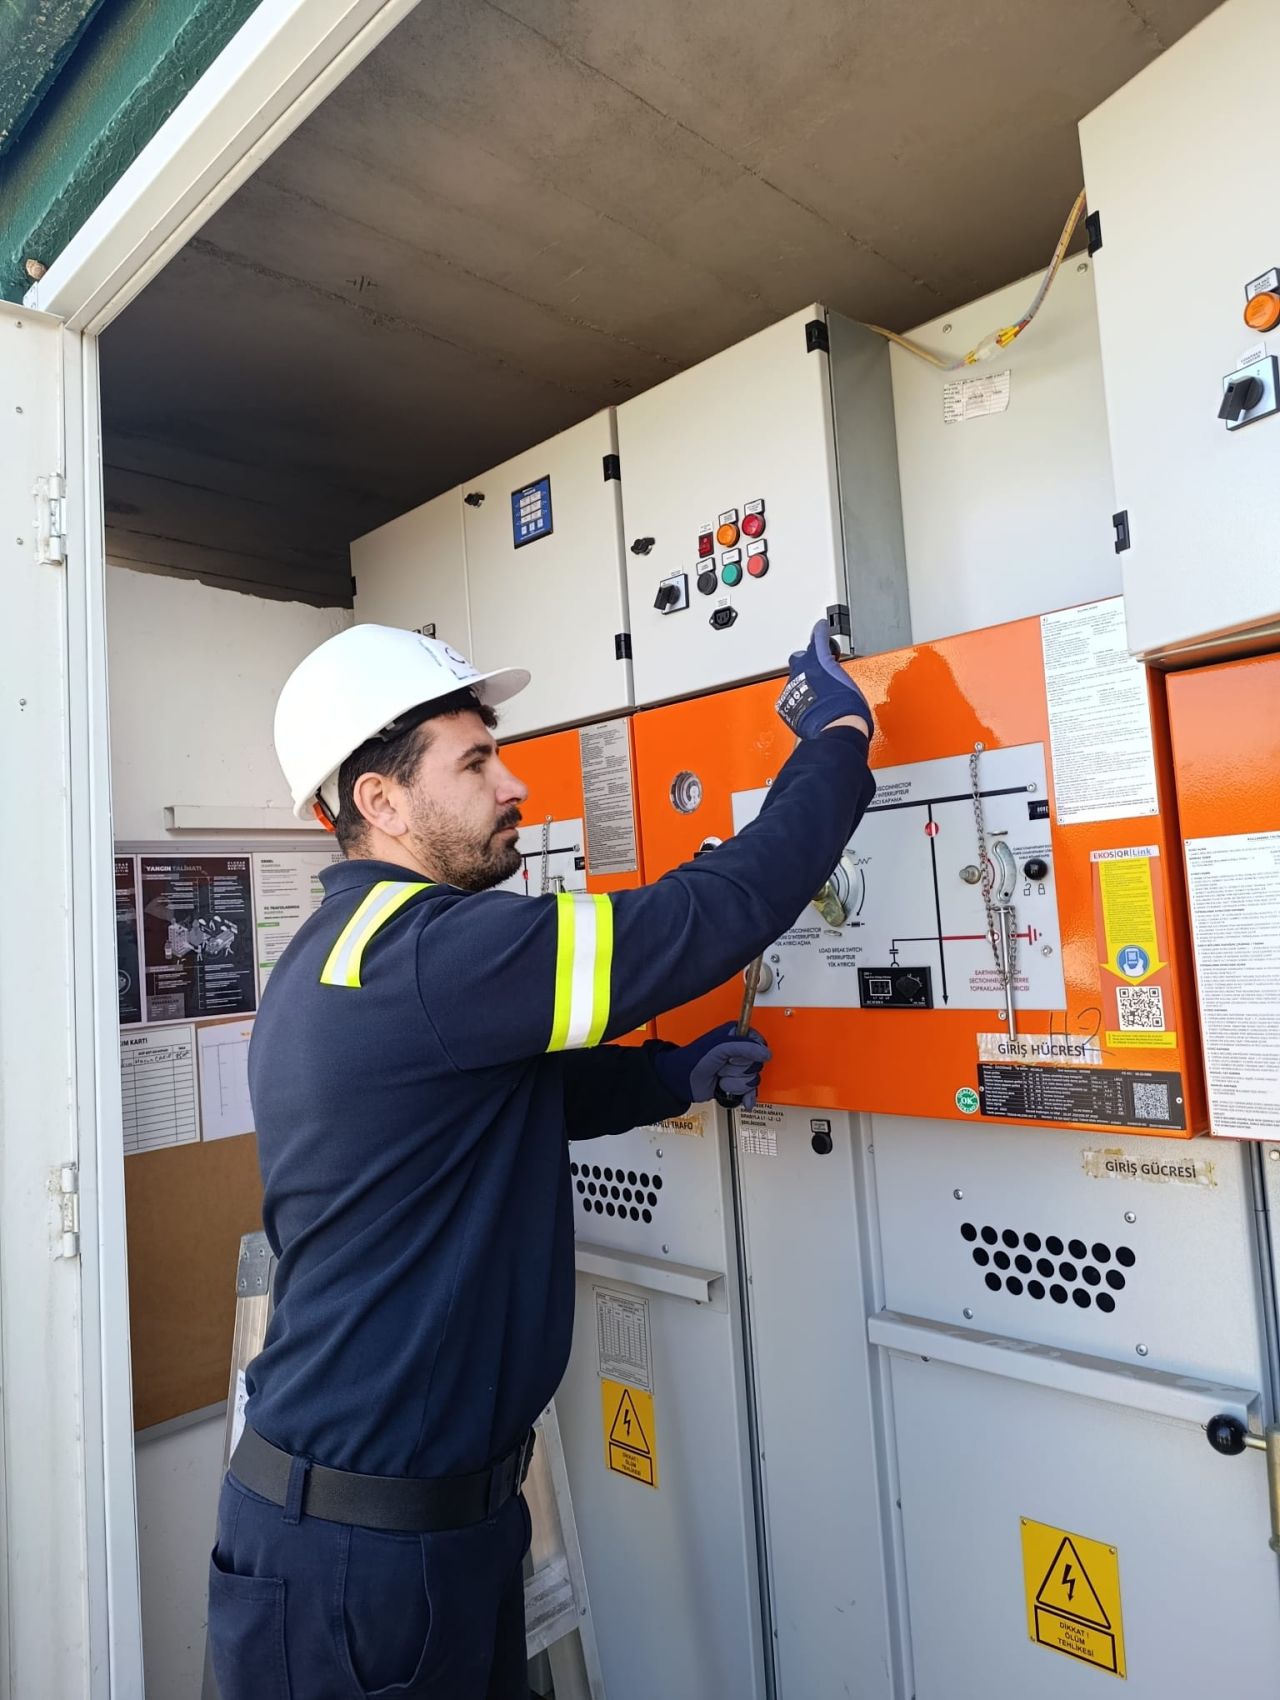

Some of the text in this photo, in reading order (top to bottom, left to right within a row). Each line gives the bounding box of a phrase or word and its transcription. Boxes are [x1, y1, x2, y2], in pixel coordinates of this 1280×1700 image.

[130, 1037, 148, 1045] KARTI
[998, 1041, 1086, 1058] GİRİŞ HÜCRESİ
[671, 1121, 693, 1130] TRAFO
[1105, 1160, 1197, 1179] GİRİŞ GÜCRESİ
